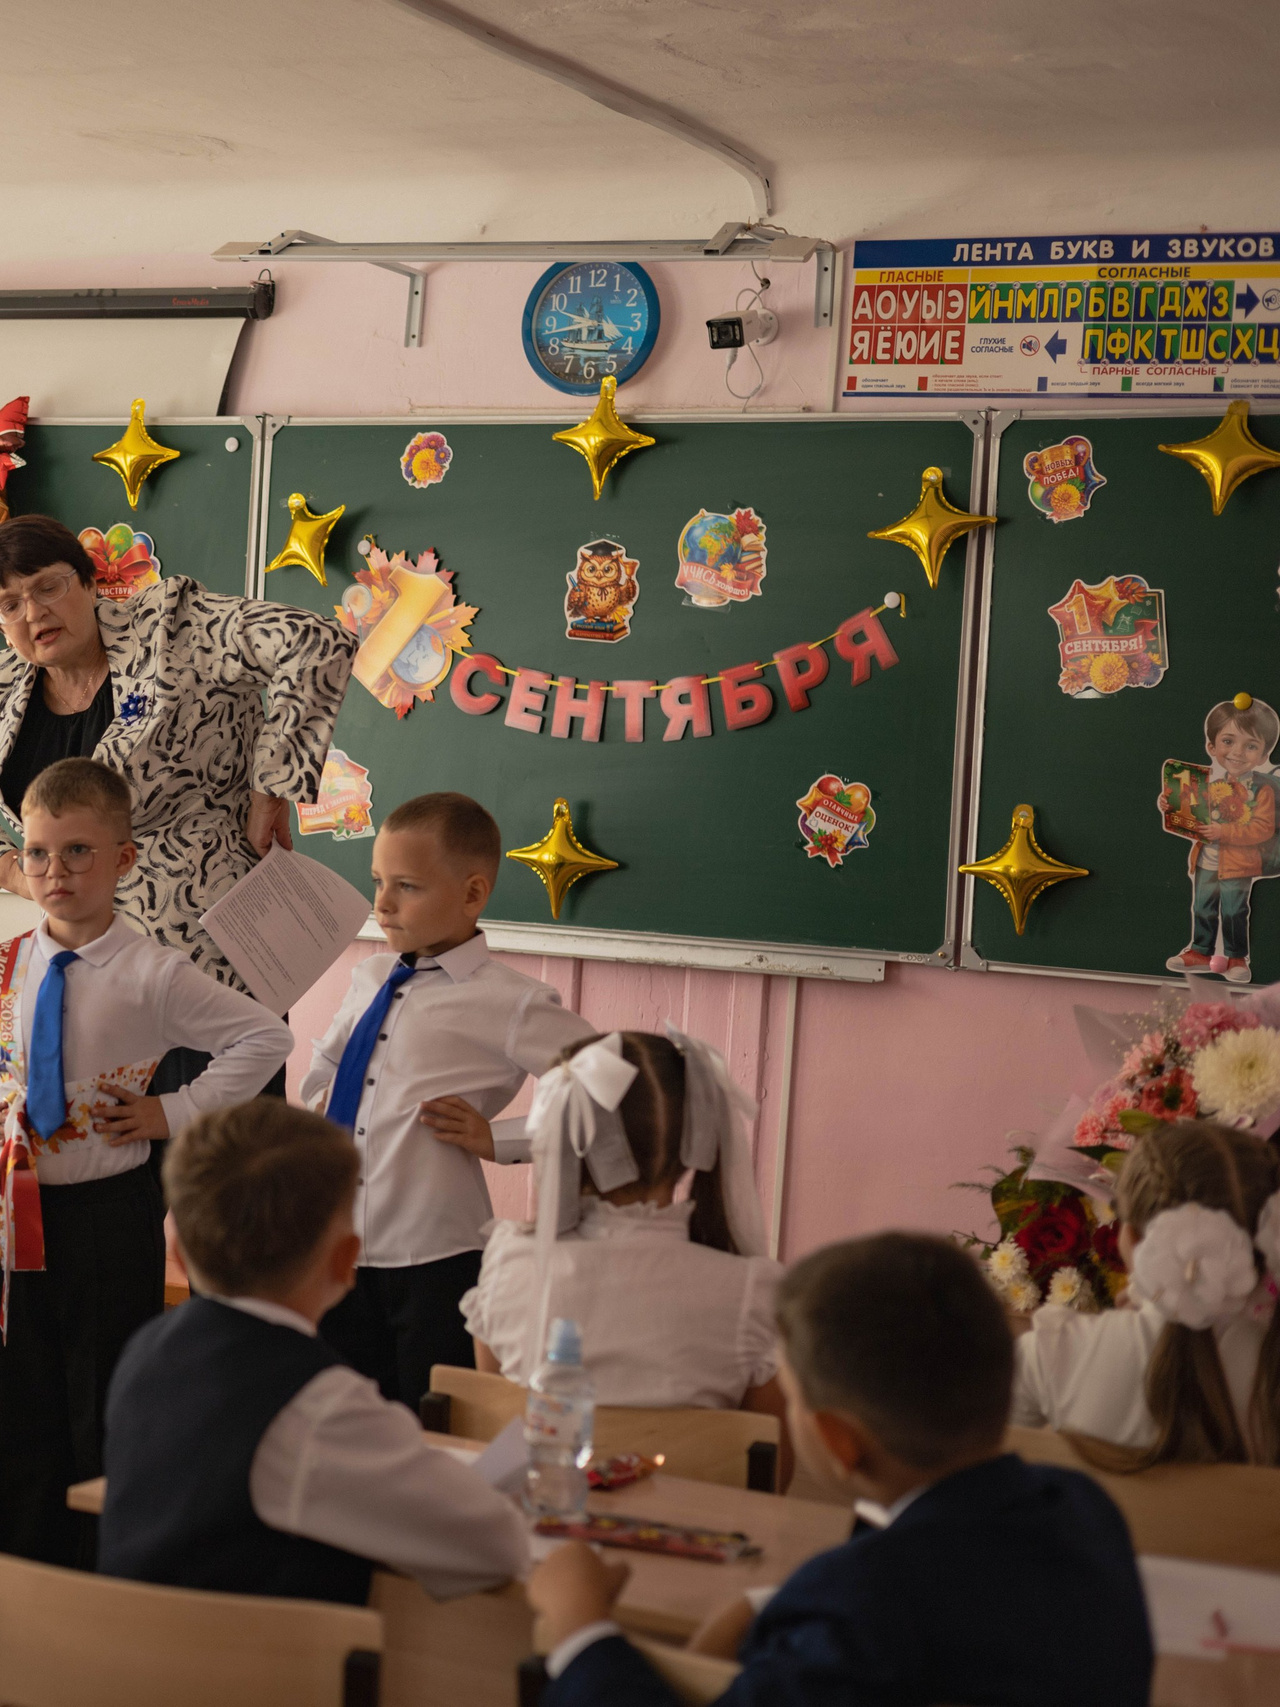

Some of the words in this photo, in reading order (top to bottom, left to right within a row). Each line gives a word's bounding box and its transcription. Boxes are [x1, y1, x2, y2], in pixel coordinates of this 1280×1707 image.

[952, 241, 1034, 262] ЛЕНТА
[1050, 239, 1114, 259] БУКВ
[1131, 239, 1150, 258] И
[1167, 237, 1274, 258] ЗВУКОВ
[589, 269, 607, 287] 12
[879, 270, 944, 283] ГЛАСНЫЕ
[1098, 267, 1191, 278] СОГЛАСНЫЕ
[568, 276, 582, 294] 11
[613, 274, 621, 292] 1
[551, 293, 567, 312] 10
[626, 289, 638, 307] 2
[545, 316, 557, 334] 9
[630, 313, 642, 331] 3
[548, 338, 559, 355] 8
[621, 336, 633, 355] 4
[970, 345, 1014, 353] СОГЛАСНЫЕ
[979, 337, 1006, 345] ГЛУХИЕ
[563, 355, 574, 373] 7
[583, 361, 595, 379] 6
[605, 354, 617, 373] 5
[1092, 366, 1140, 376] ПАРНЫЕ
[1146, 366, 1216, 376] СОГЛАСНЫЕ
[1044, 458, 1074, 472] НОВЫХ
[1043, 466, 1080, 485] ПОБЕД!
[682, 565, 715, 585] УЧИСЬ
[716, 579, 749, 596] хорошо!
[1065, 593, 1091, 635] 1
[1064, 634, 1144, 654] СЕНТЯБРЯ!
[450, 606, 900, 743] СЕНТЯБРЯ
[823, 799, 858, 821] ОТЛИЧНЫХ
[814, 811, 855, 834] ОЦЕНОК!
[0, 999, 14, 1042] 2026
